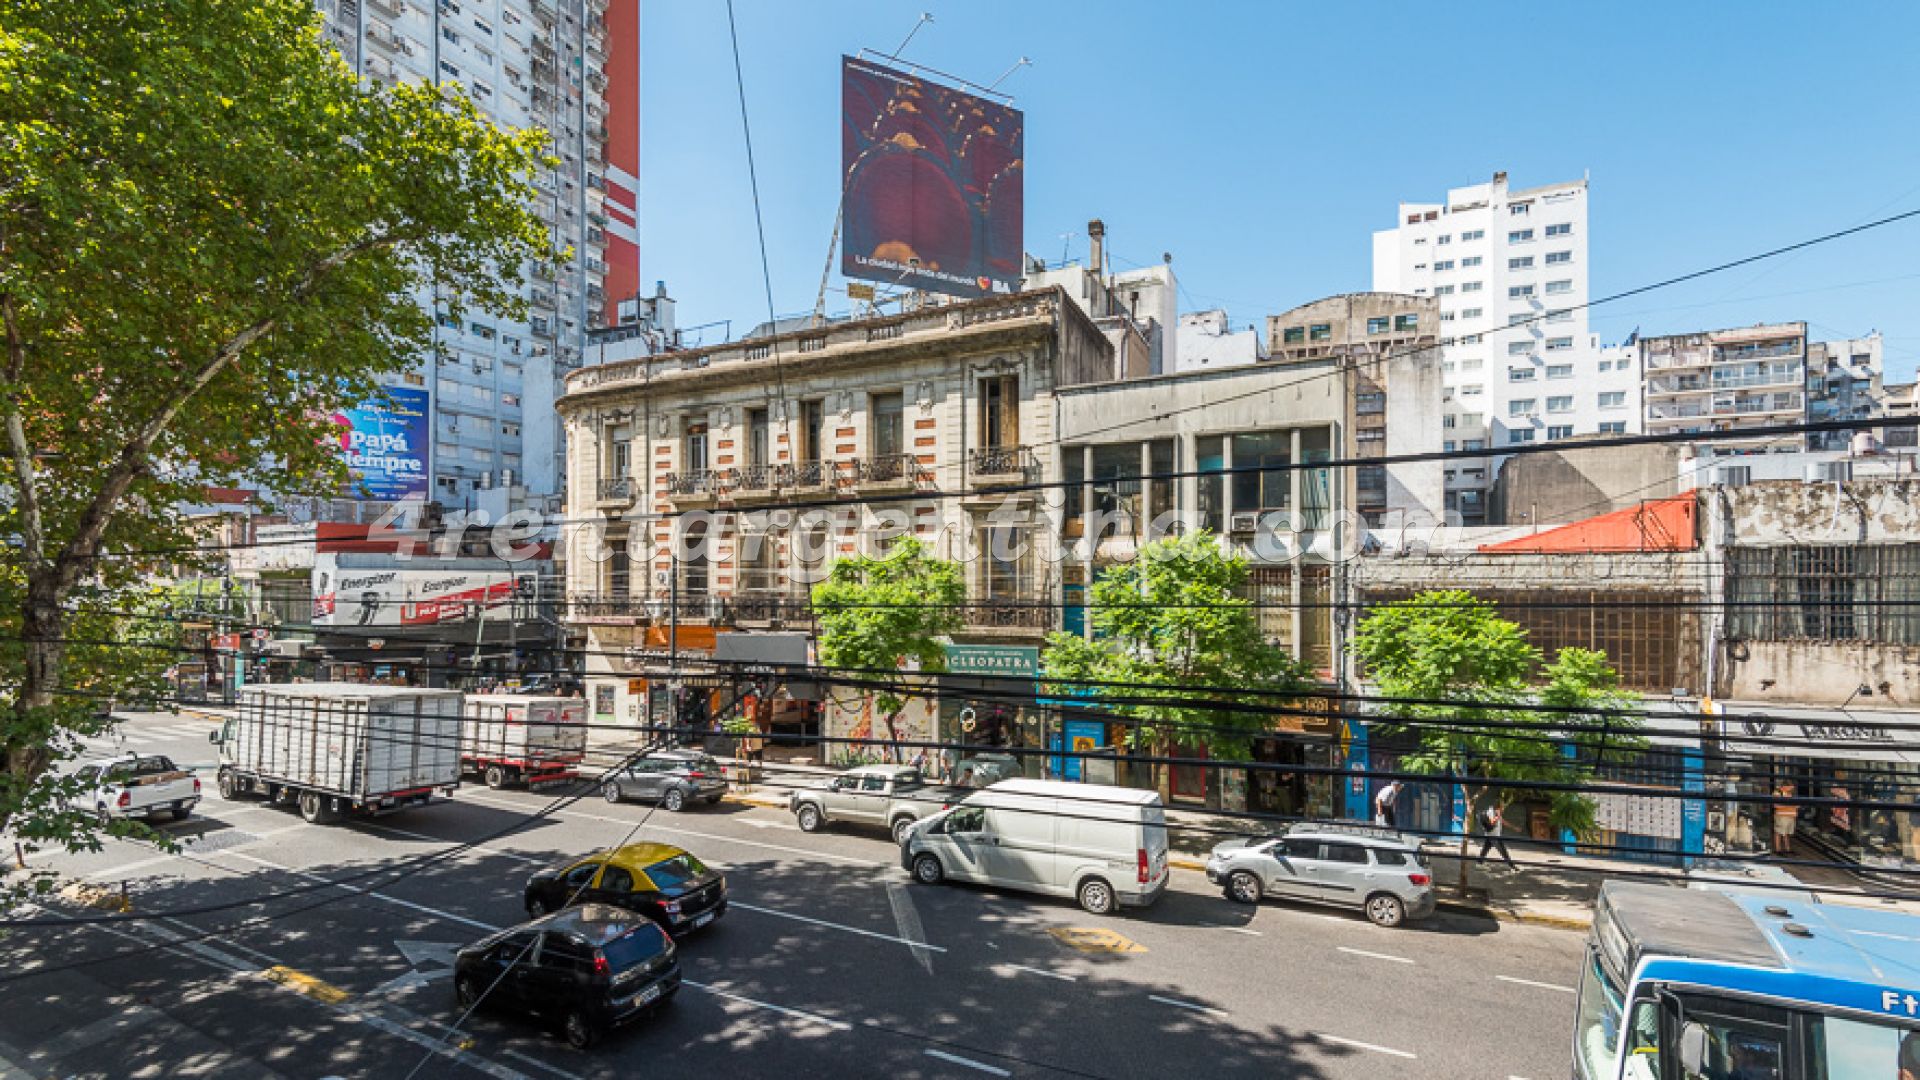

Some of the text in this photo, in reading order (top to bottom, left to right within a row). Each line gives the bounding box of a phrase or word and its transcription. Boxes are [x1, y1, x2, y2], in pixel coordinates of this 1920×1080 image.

[349, 431, 408, 453] Papá
[340, 572, 397, 591] Energizer
[422, 576, 468, 593] Energizer
[950, 655, 1032, 669] CLEOPATRA
